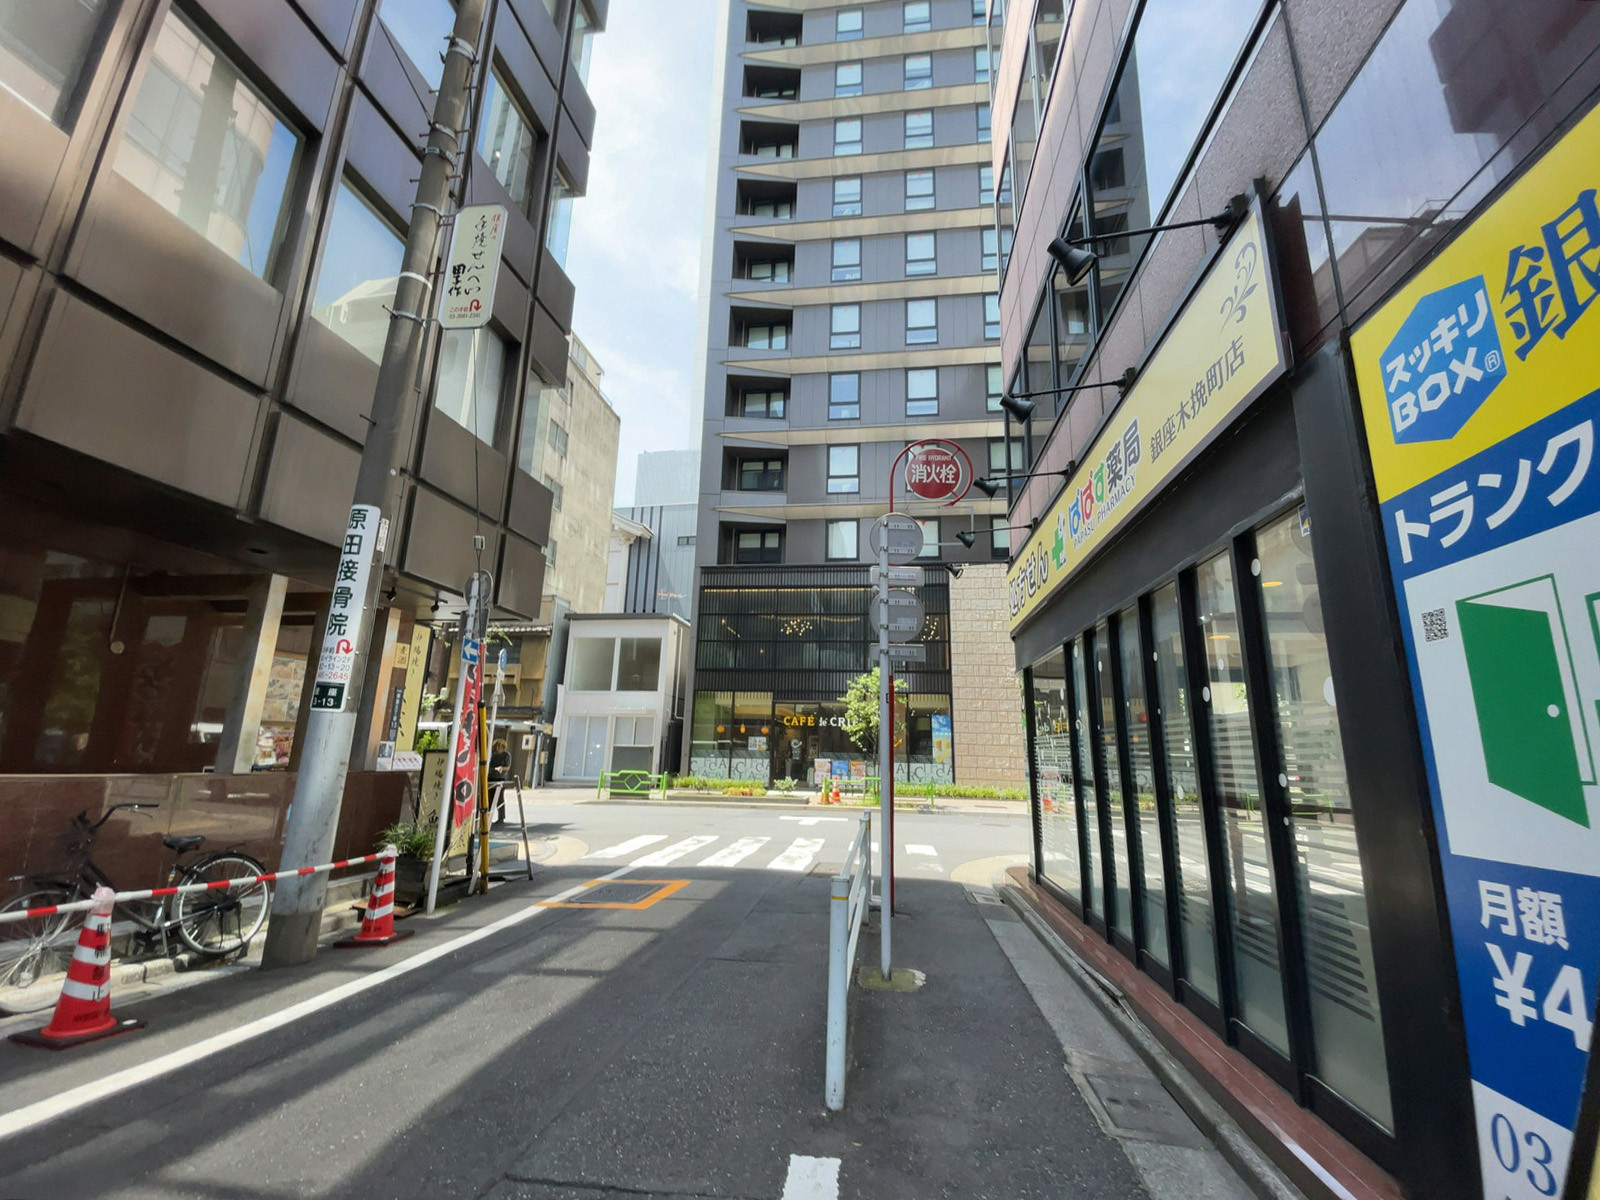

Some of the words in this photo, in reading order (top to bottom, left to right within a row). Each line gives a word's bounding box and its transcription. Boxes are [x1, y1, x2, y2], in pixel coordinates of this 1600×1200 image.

[1500, 188, 1600, 362] 銀
[1385, 289, 1488, 393] スッキリ
[1150, 335, 1246, 464] 銀座木挽町店
[911, 464, 957, 484] 消火栓
[1068, 418, 1141, 539] ぱぱす薬局
[1097, 471, 1136, 523] PHARMACY
[1394, 419, 1593, 563] トランク
[327, 508, 368, 636] 原田接骨院
[1477, 879, 1569, 950] 月額
[1491, 1113, 1557, 1197] 03
